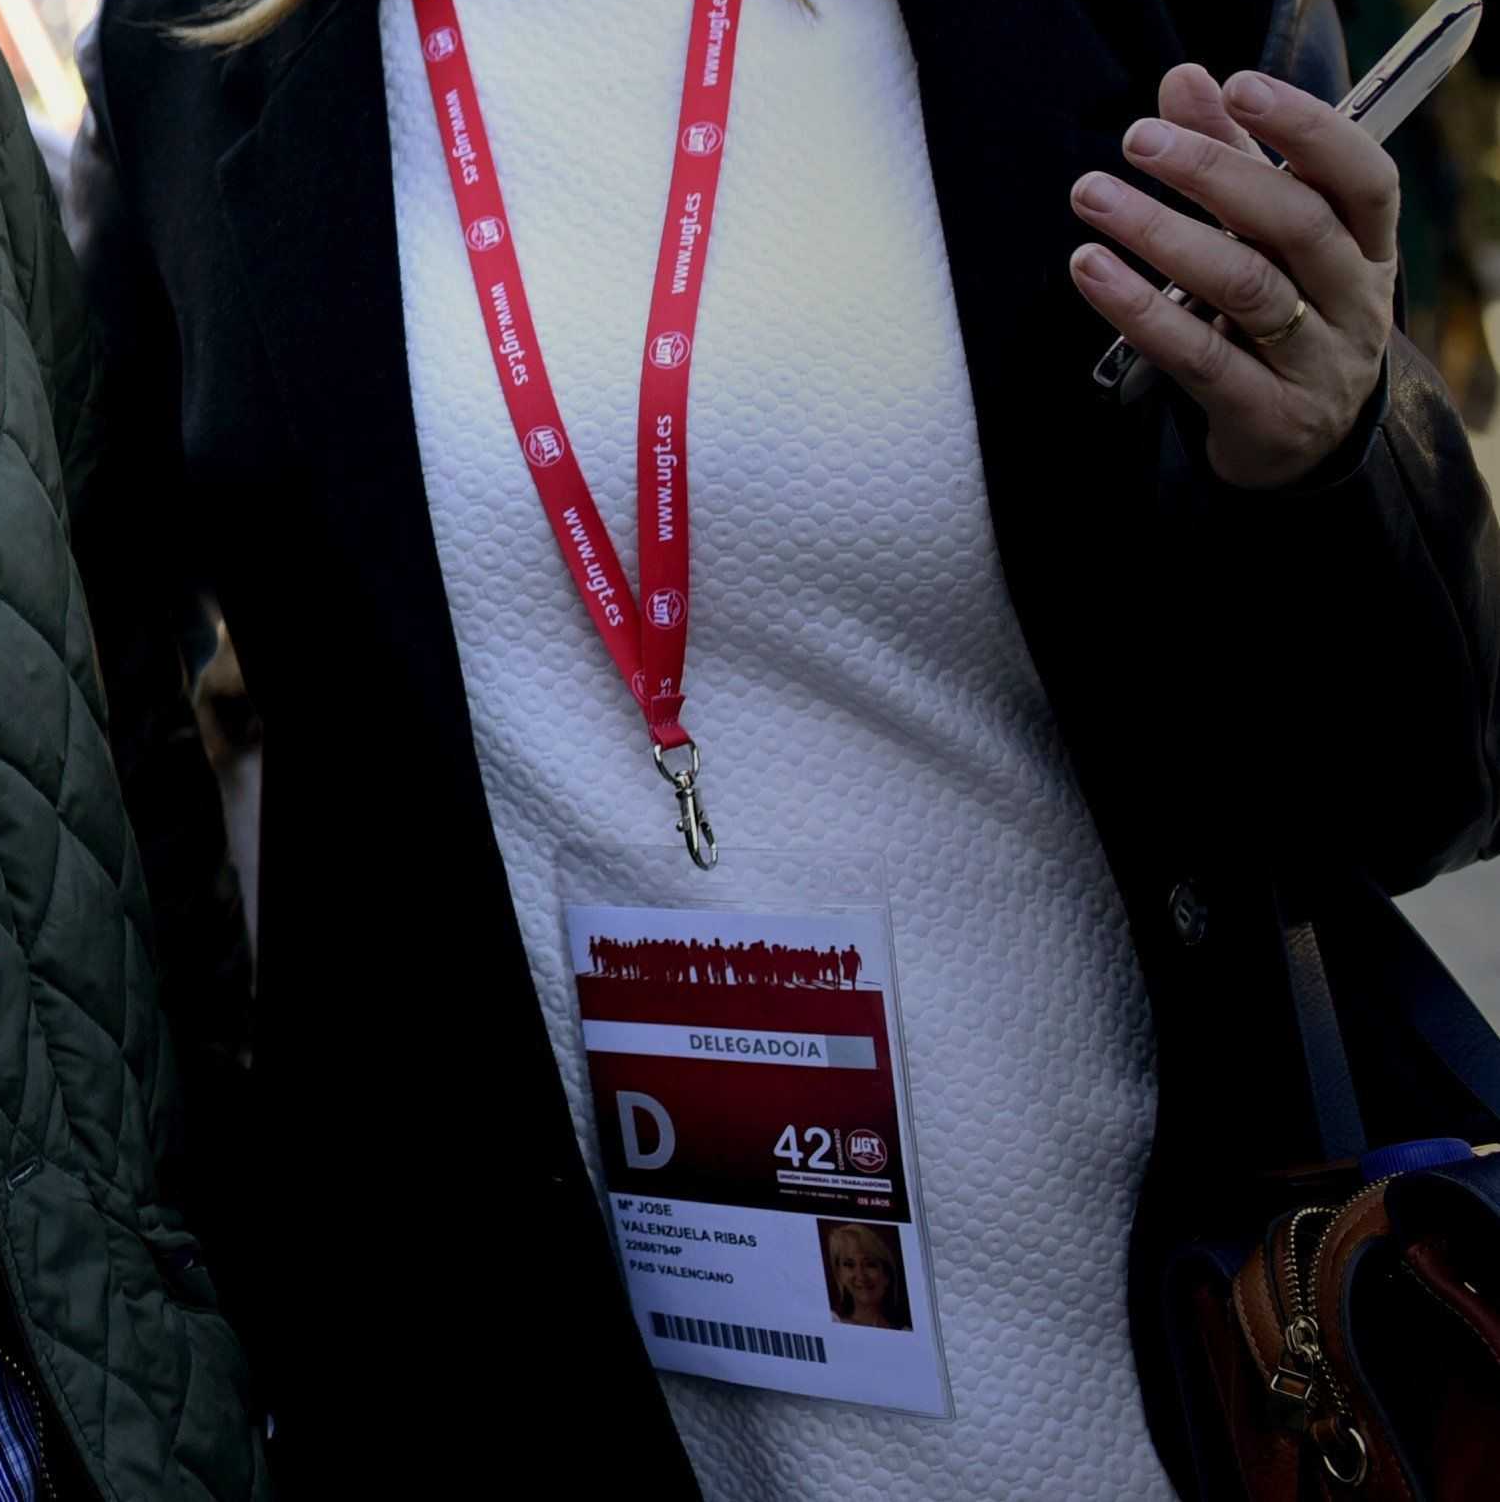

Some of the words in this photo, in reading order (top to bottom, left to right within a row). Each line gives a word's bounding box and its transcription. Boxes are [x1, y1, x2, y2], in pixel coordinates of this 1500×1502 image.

[445, 88, 480, 187] www.ugt.es
[670, 192, 702, 296] www.ugt.es
[489, 281, 529, 387] www.ugt.es
[652, 413, 679, 544] www.ugt.es
[561, 505, 625, 629] www.ugt.es
[689, 1033, 822, 1059] DELEGADO/A
[615, 1089, 677, 1170] D
[773, 1123, 836, 1171] 42
[620, 1219, 712, 1243] VALENZUELA
[714, 1230, 758, 1248] RIBAS
[636, 1201, 673, 1217] JOSE
[629, 1259, 656, 1274] PAIS
[658, 1263, 734, 1285] VALENCIANO
